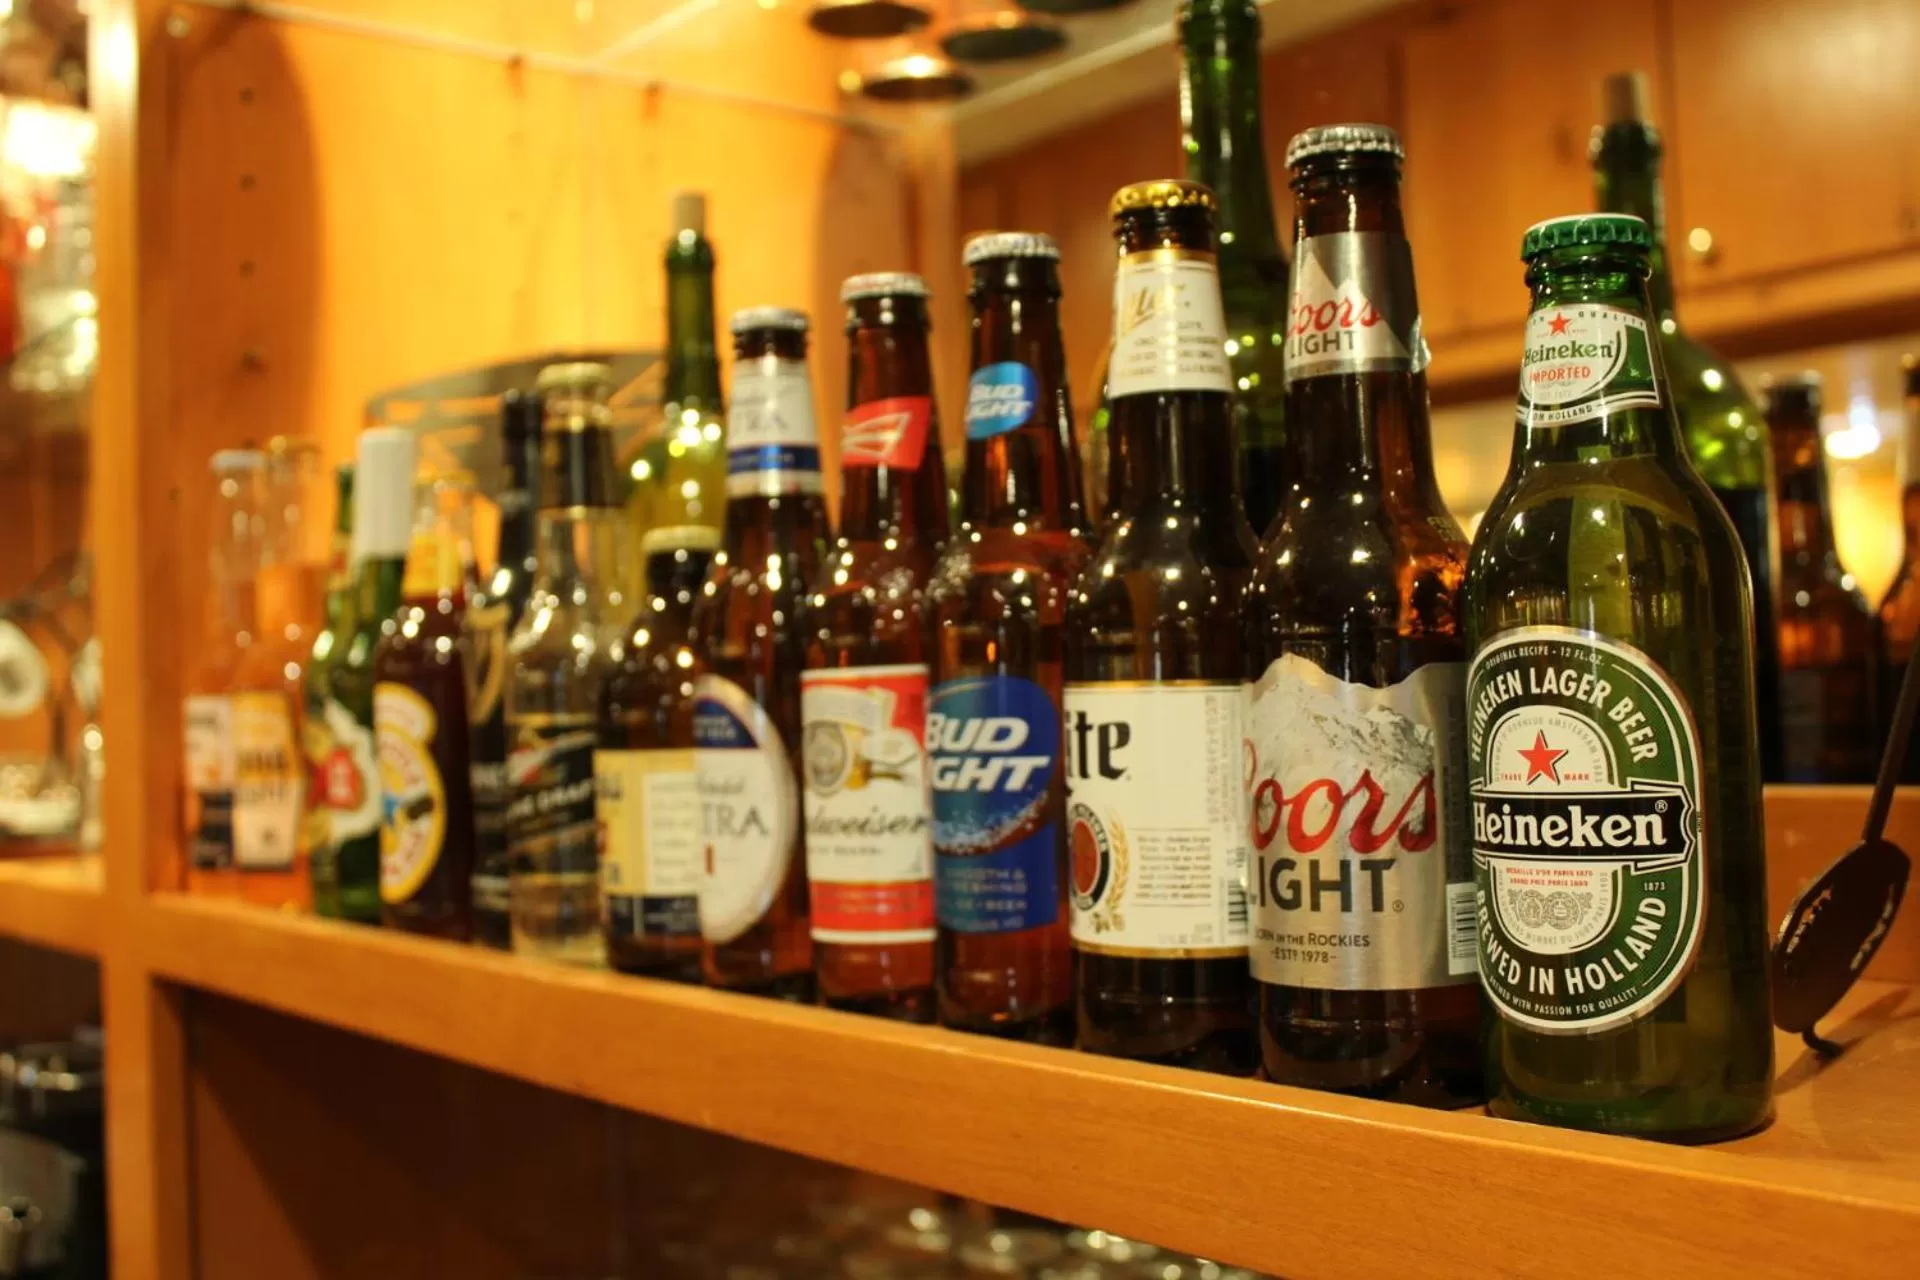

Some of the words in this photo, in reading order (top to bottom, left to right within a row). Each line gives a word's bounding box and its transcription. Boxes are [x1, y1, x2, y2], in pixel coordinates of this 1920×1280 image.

[1520, 645, 1549, 657] RECIPE
[1560, 647, 1572, 658] 12
[925, 712, 1030, 752] BUD
[1471, 668, 1524, 762] HEINEKEN
[1529, 666, 1612, 709] LAGER
[1607, 696, 1659, 763] BEER
[929, 755, 1051, 792] GHT
[1563, 772, 1590, 781] MARK
[1473, 802, 1668, 848] Heineken
[1256, 855, 1398, 914] IGHT
[1643, 881, 1666, 892] 1873
[1286, 934, 1304, 945] THE
[1308, 932, 1371, 948] ROCKIES
[1476, 890, 1522, 985] BREWED
[1529, 965, 1555, 996] IN
[1564, 896, 1667, 996] HOLLAND
[1534, 1003, 1573, 1016] PASSION
[1576, 1003, 1596, 1015] FOR
[1598, 986, 1639, 1010] QUALITY
